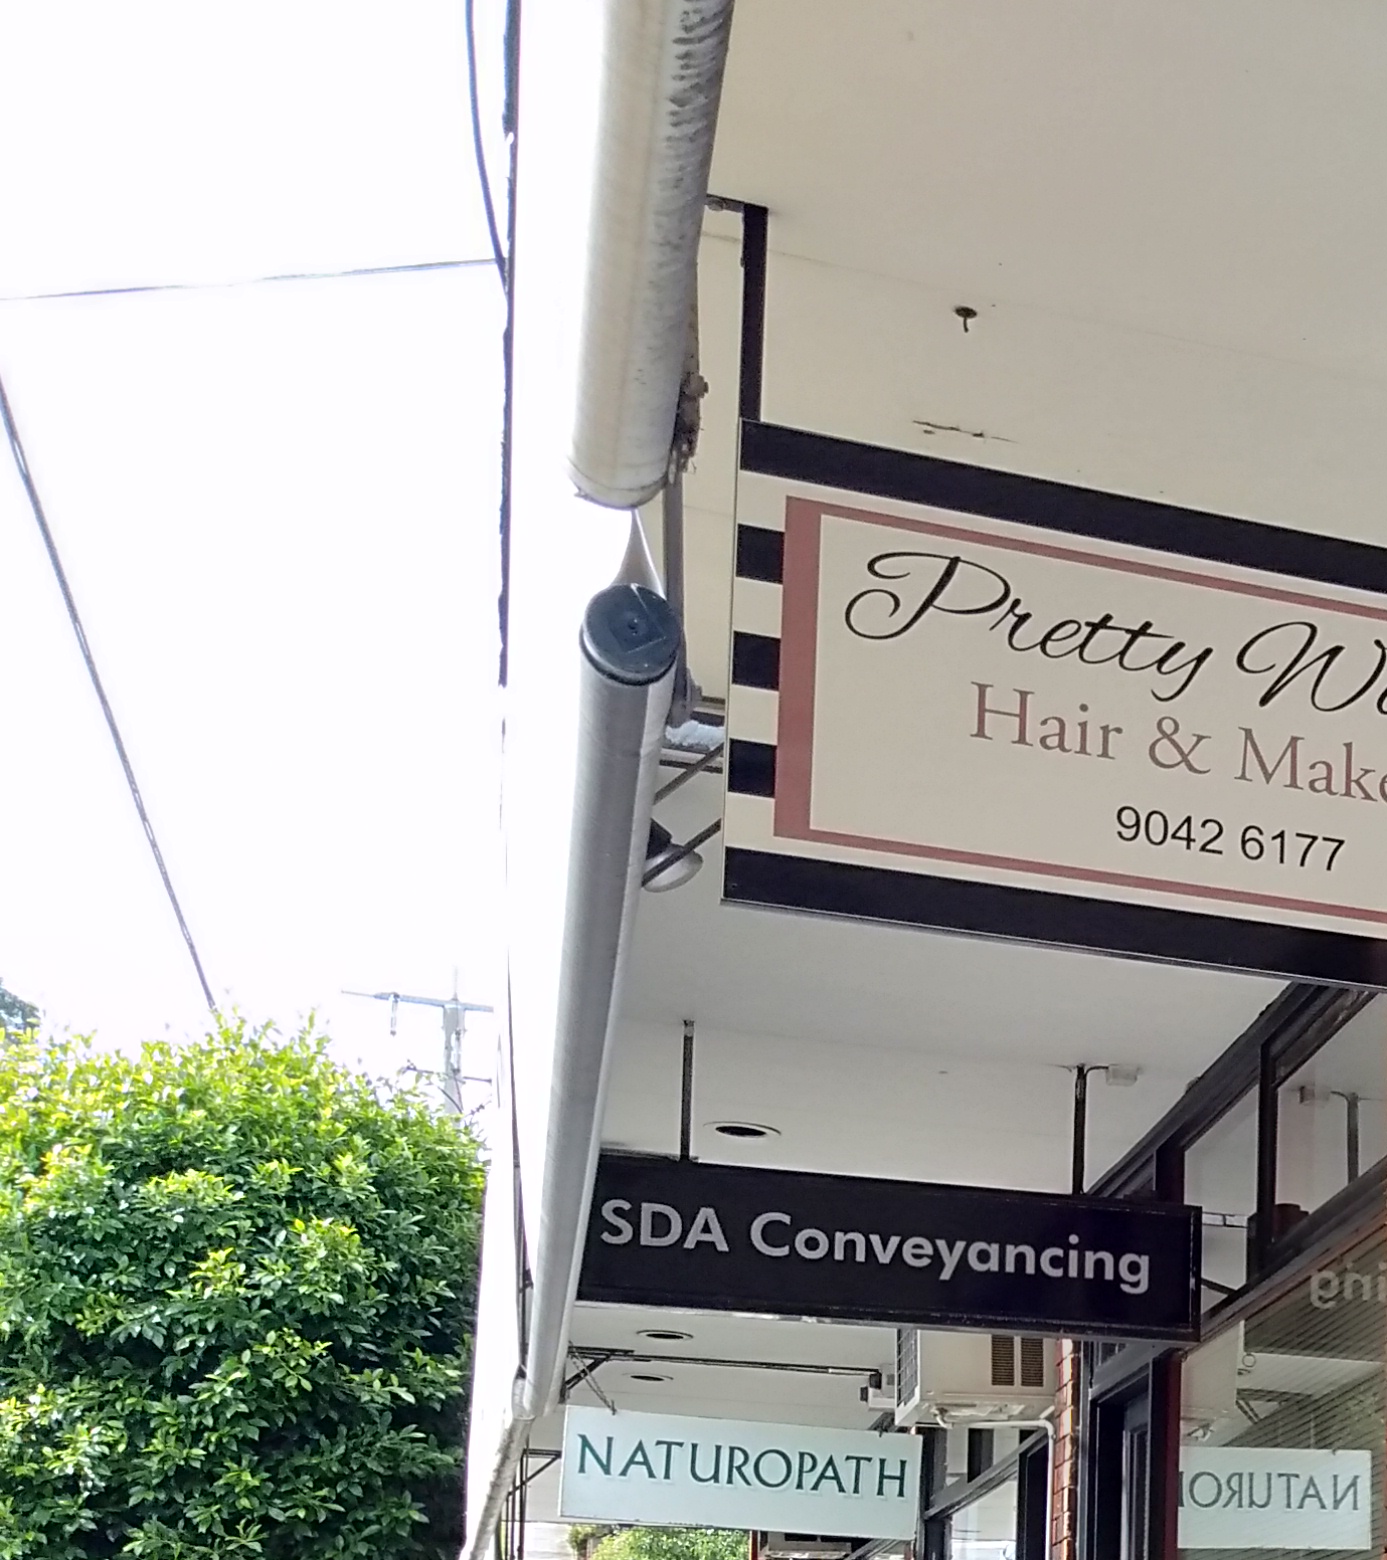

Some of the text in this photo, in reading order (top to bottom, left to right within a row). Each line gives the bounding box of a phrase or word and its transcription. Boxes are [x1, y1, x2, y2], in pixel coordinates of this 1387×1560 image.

[844, 550, 1213, 702] Pretty
[969, 681, 1122, 761] Hair
[1148, 718, 1211, 777] &
[1115, 806, 1346, 873] 9042 6177
[601, 1198, 1150, 1294] SDA Conveyancing
[576, 1433, 908, 1499] NATUROPATH
